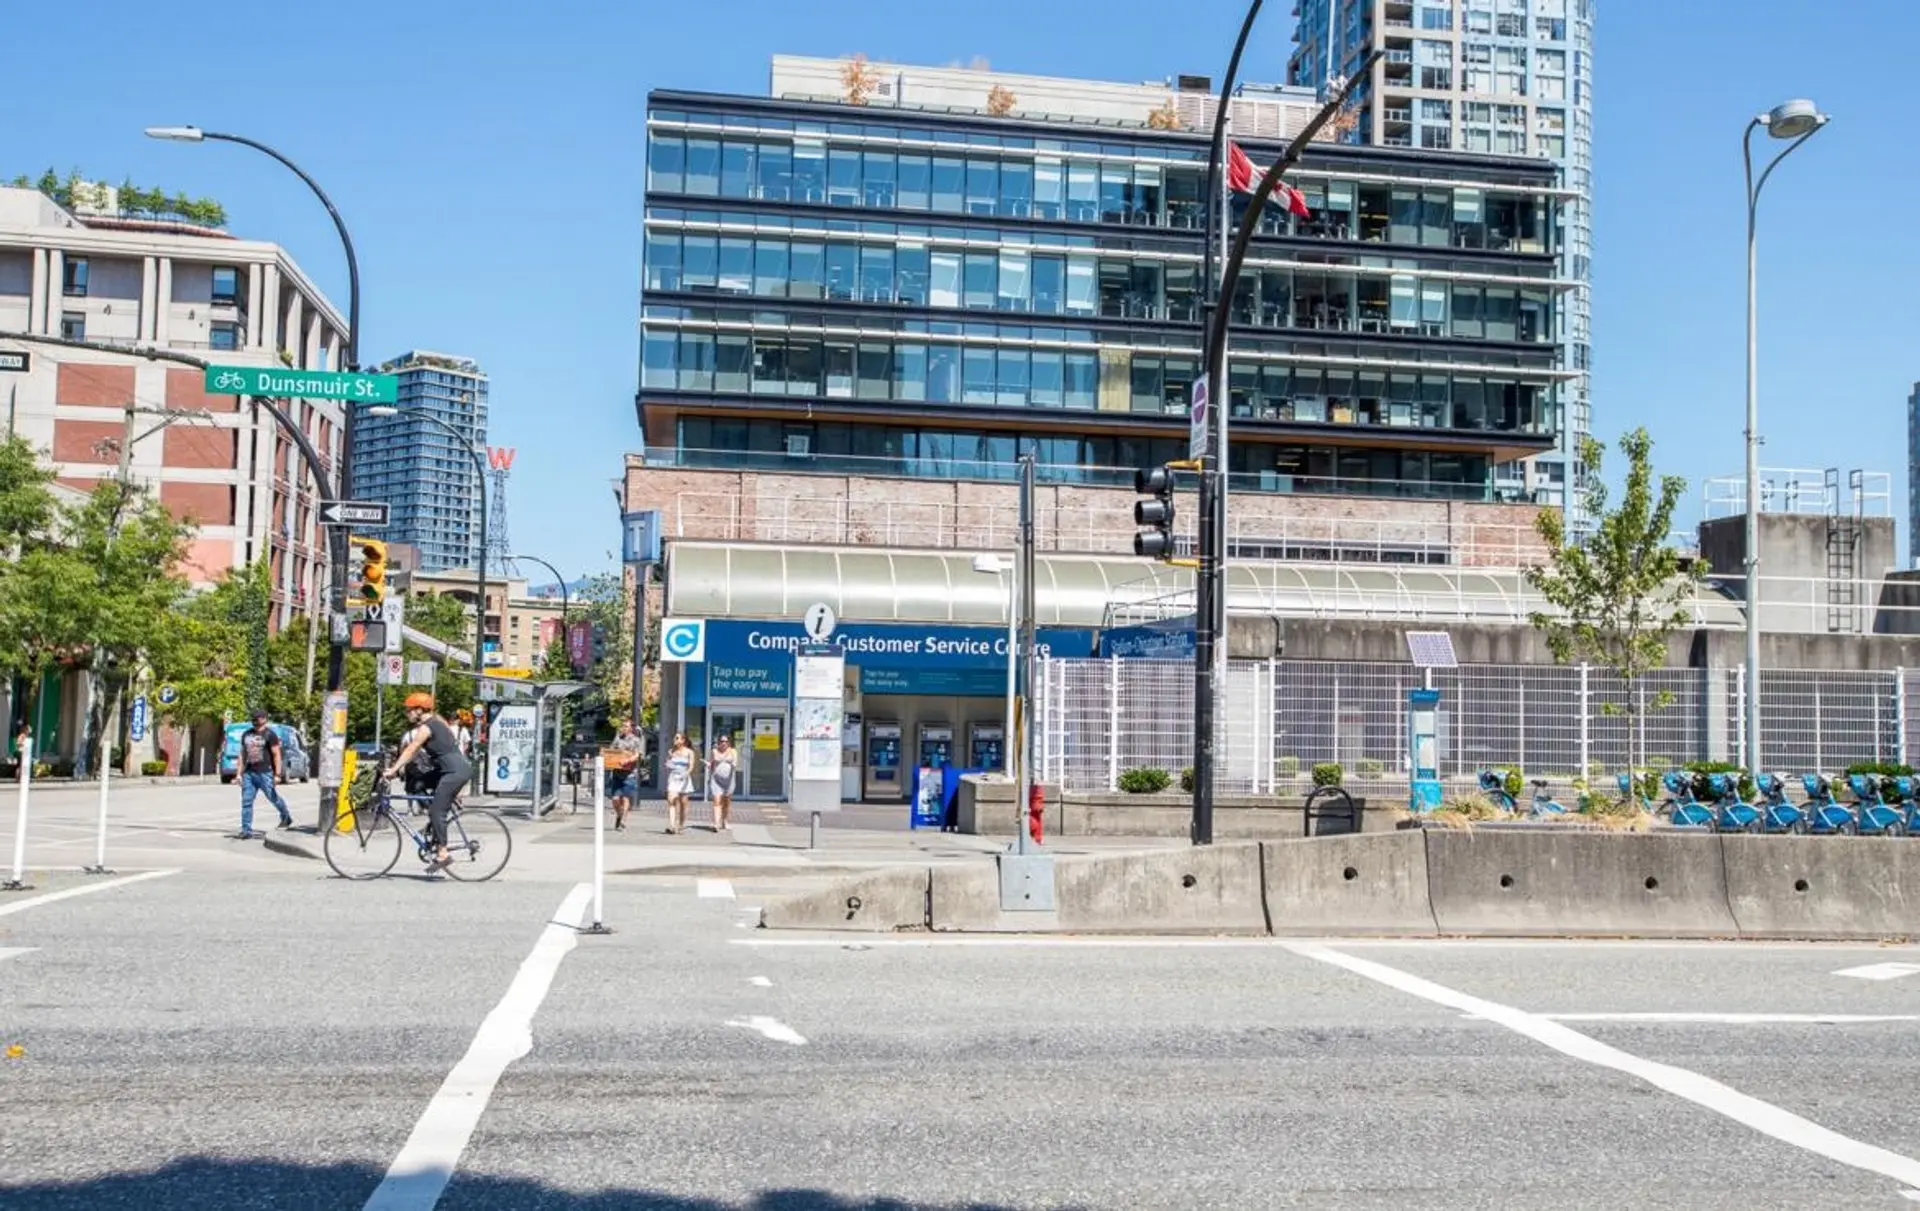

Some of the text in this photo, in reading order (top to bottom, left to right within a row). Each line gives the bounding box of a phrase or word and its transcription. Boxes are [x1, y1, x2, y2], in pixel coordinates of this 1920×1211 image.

[258, 373, 381, 397] Dunsmuir St.
[486, 447, 516, 470] W
[361, 509, 381, 520] WAY
[836, 634, 922, 653] Customer
[925, 637, 990, 656] Service
[712, 666, 768, 680] Tap to pay
[712, 679, 731, 689] the
[732, 680, 758, 692] easy
